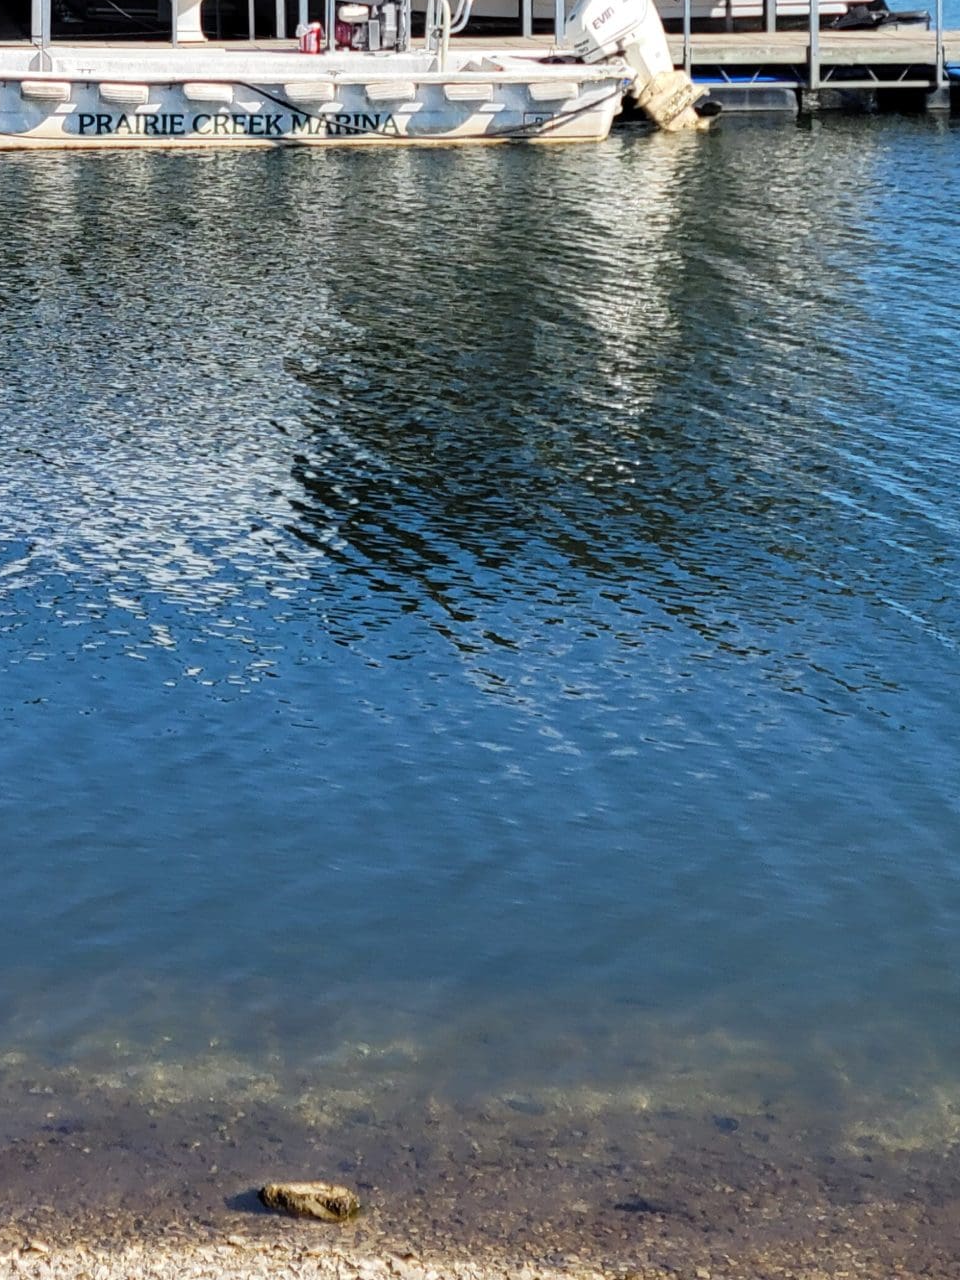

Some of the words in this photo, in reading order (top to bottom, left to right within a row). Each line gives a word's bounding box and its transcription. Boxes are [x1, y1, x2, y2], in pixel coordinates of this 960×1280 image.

[78, 113, 185, 135] PRAIRIE
[191, 113, 285, 135] CREEK
[290, 113, 400, 135] MARINA
